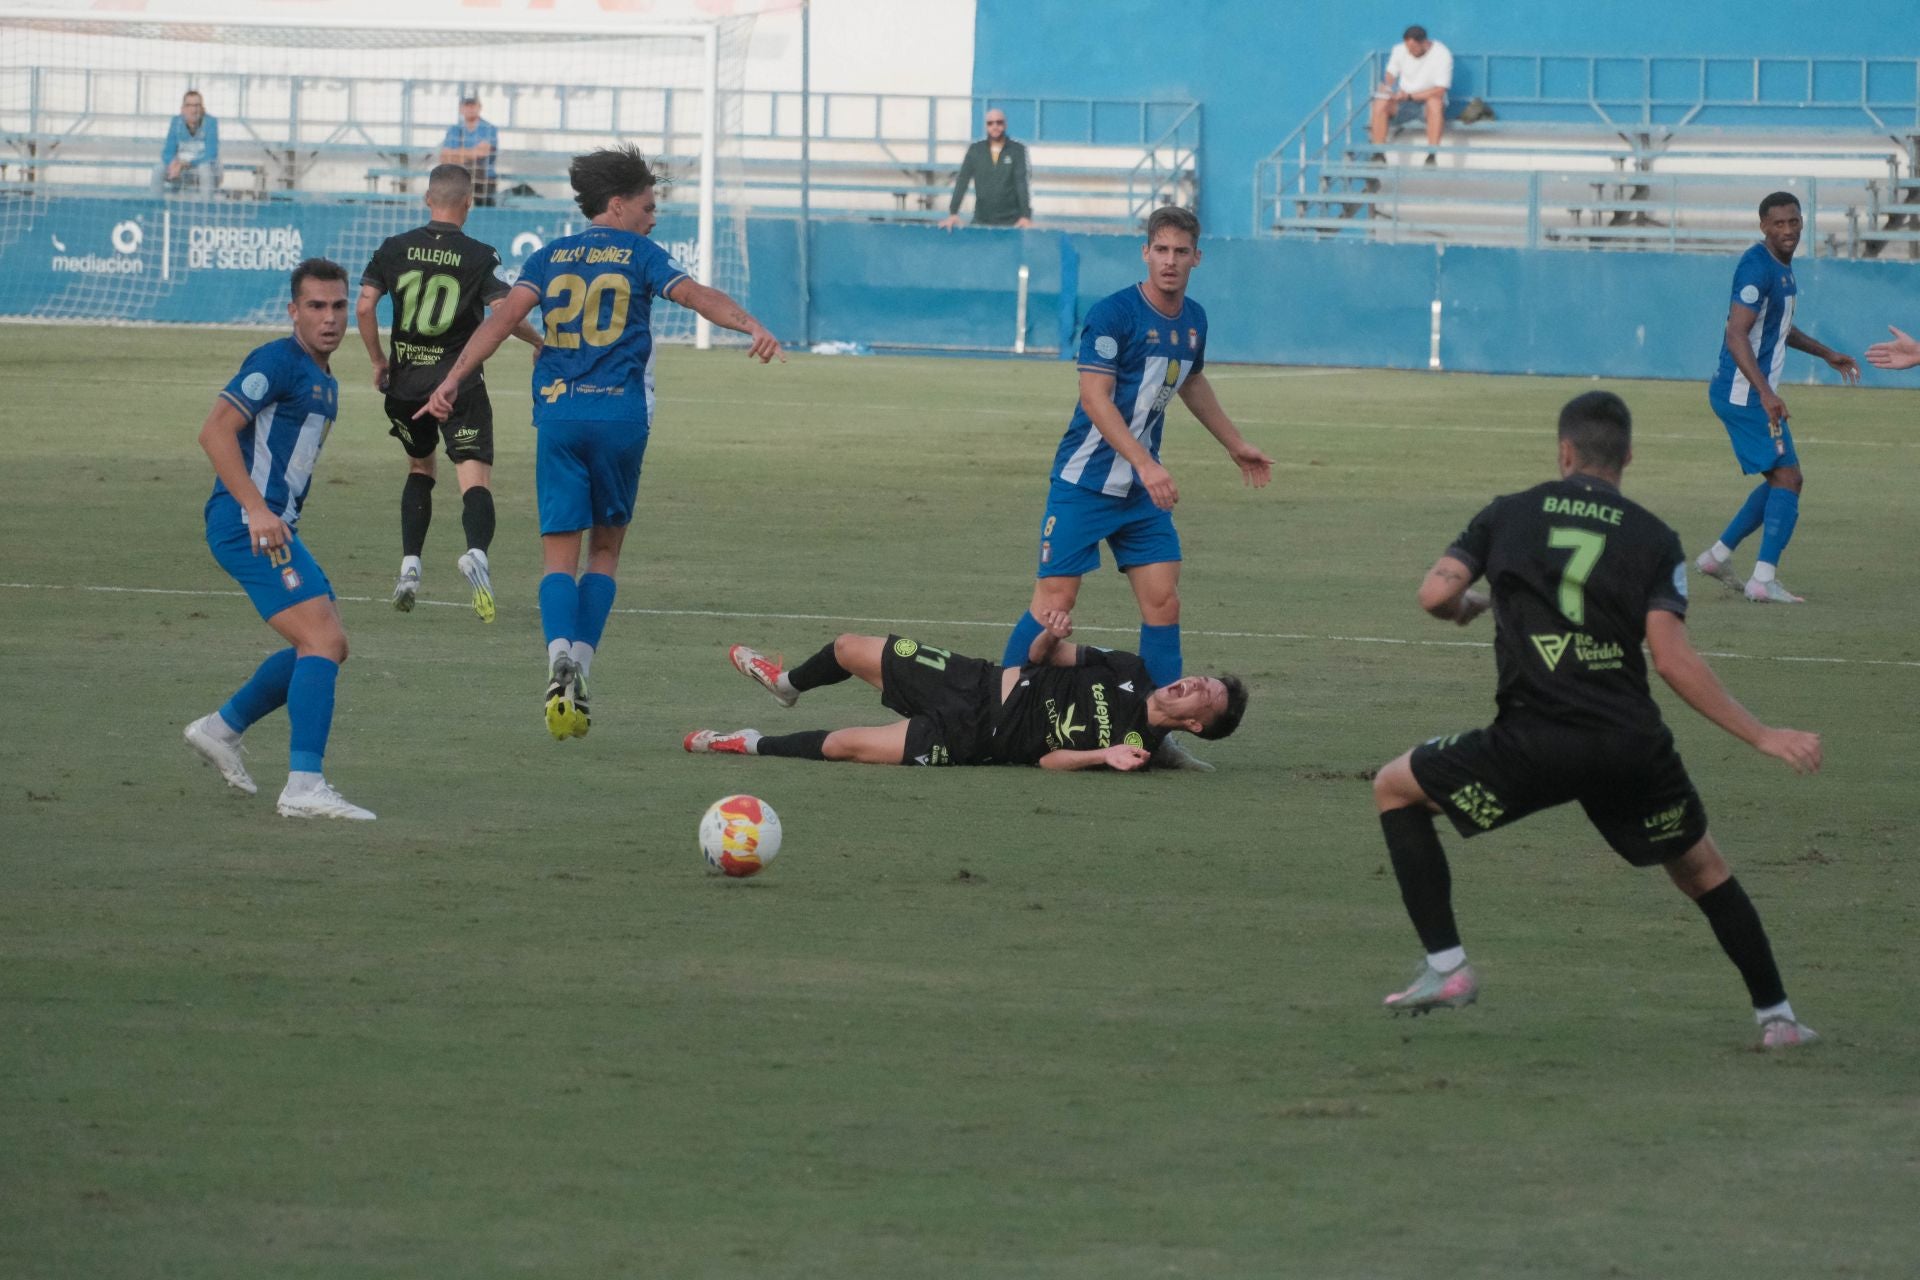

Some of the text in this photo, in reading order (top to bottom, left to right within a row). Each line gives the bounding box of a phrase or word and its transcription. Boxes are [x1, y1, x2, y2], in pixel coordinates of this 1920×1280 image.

[189, 223, 303, 251] CORREDURÍA
[189, 248, 302, 272] DE SEGUROS
[407, 247, 461, 267] CALLEJÓN
[396, 270, 461, 336] 10
[544, 273, 632, 349] 20
[1543, 496, 1624, 525] BARACE
[1044, 516, 1056, 537] 8
[1549, 527, 1607, 626] 7
[1091, 683, 1112, 749] telepizz
